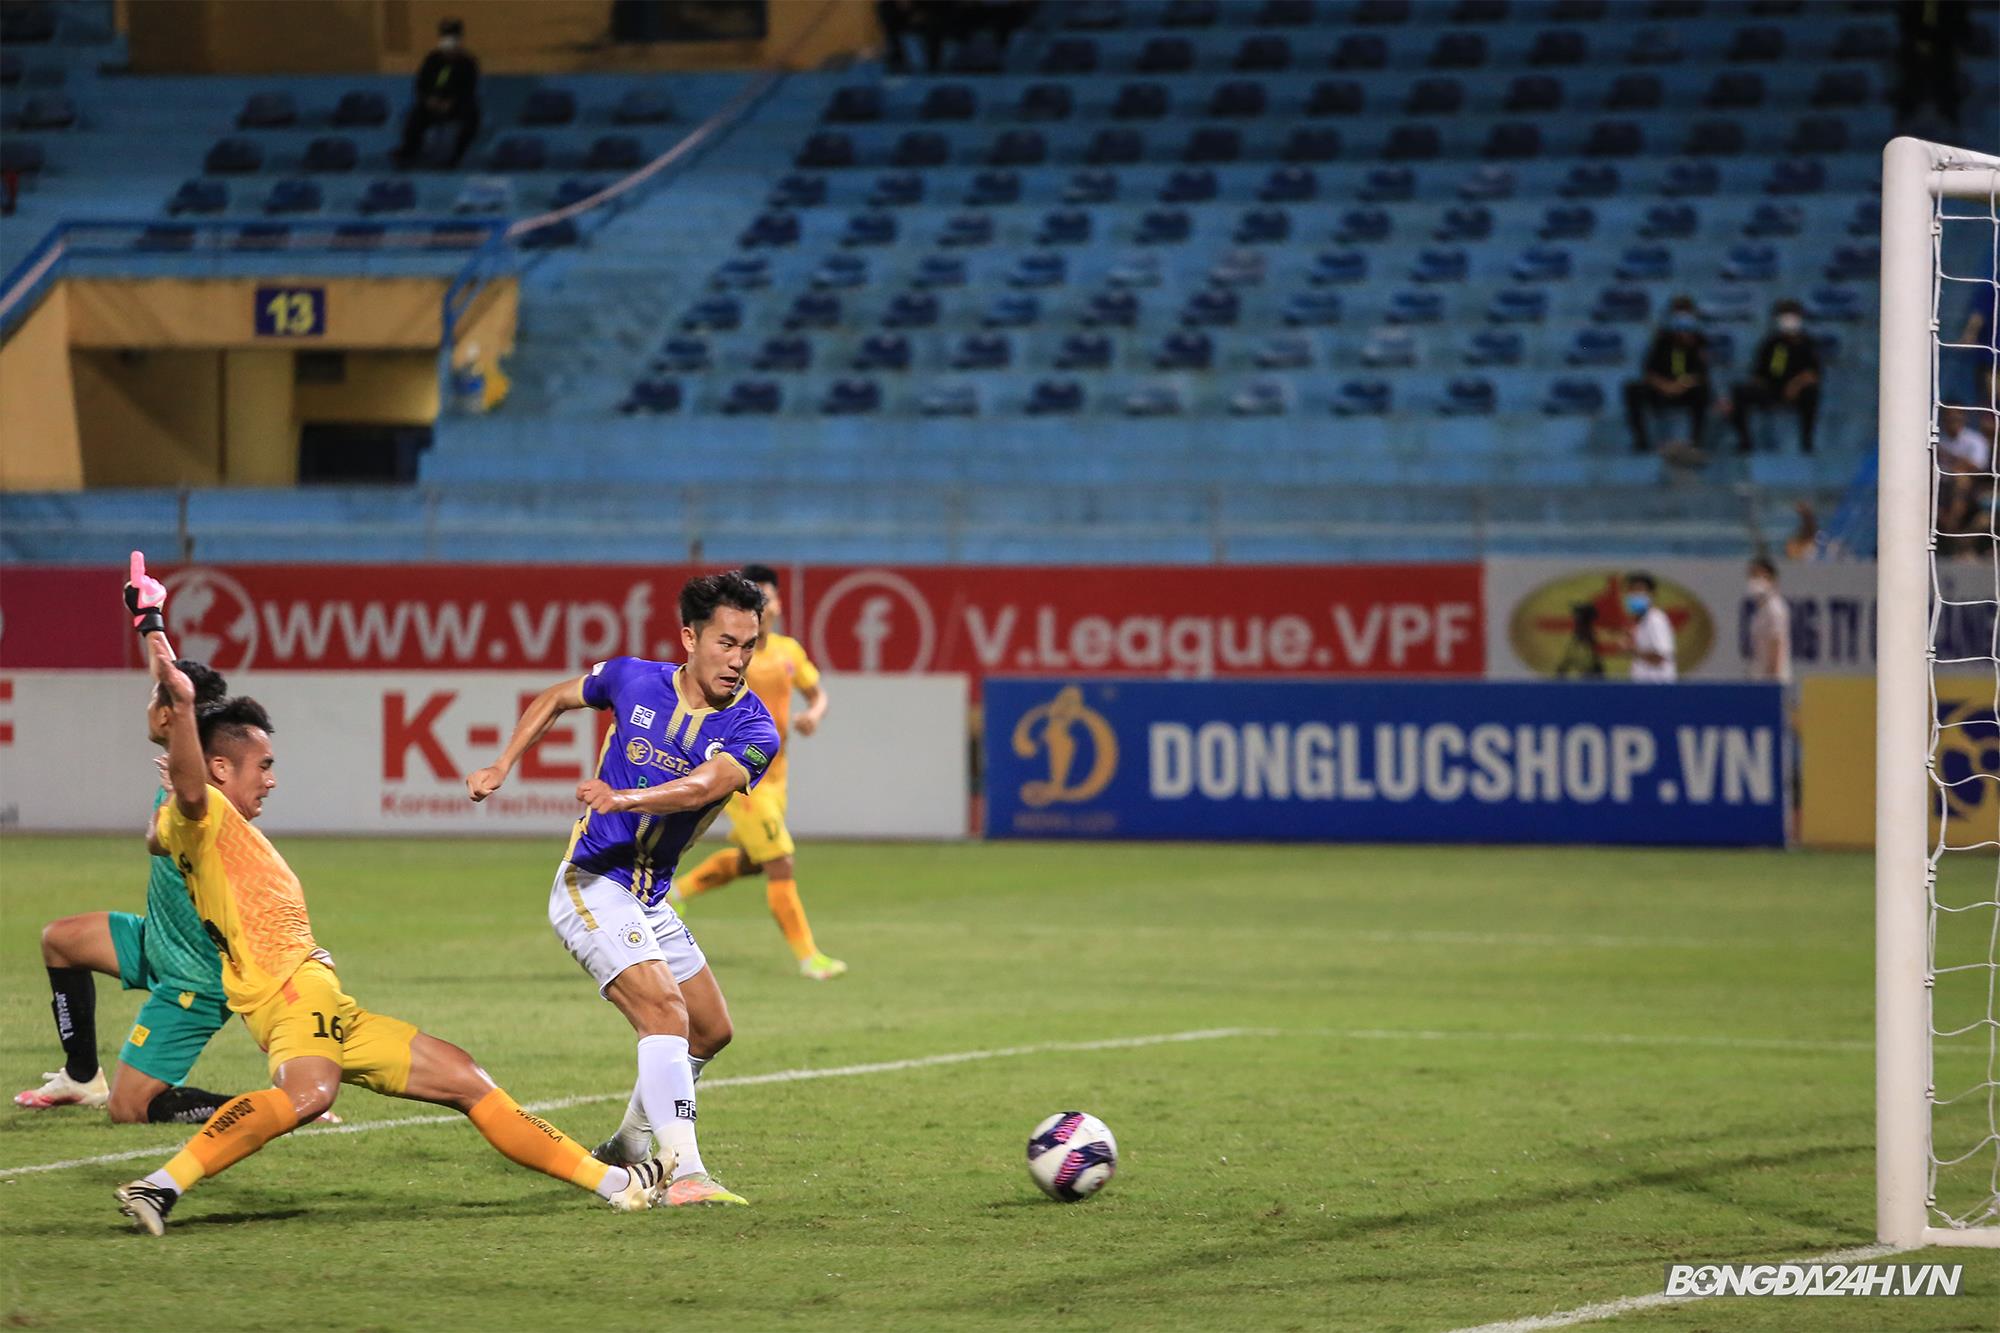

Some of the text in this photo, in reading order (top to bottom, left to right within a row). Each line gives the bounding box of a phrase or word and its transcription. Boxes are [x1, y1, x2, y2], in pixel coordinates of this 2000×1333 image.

[265, 292, 316, 332] 13
[264, 582, 680, 672] www.vpf.
[964, 602, 1475, 679] V.League.VPF
[1149, 723, 1774, 804] DONGLUCSHOP.VN
[312, 1011, 344, 1044] 16
